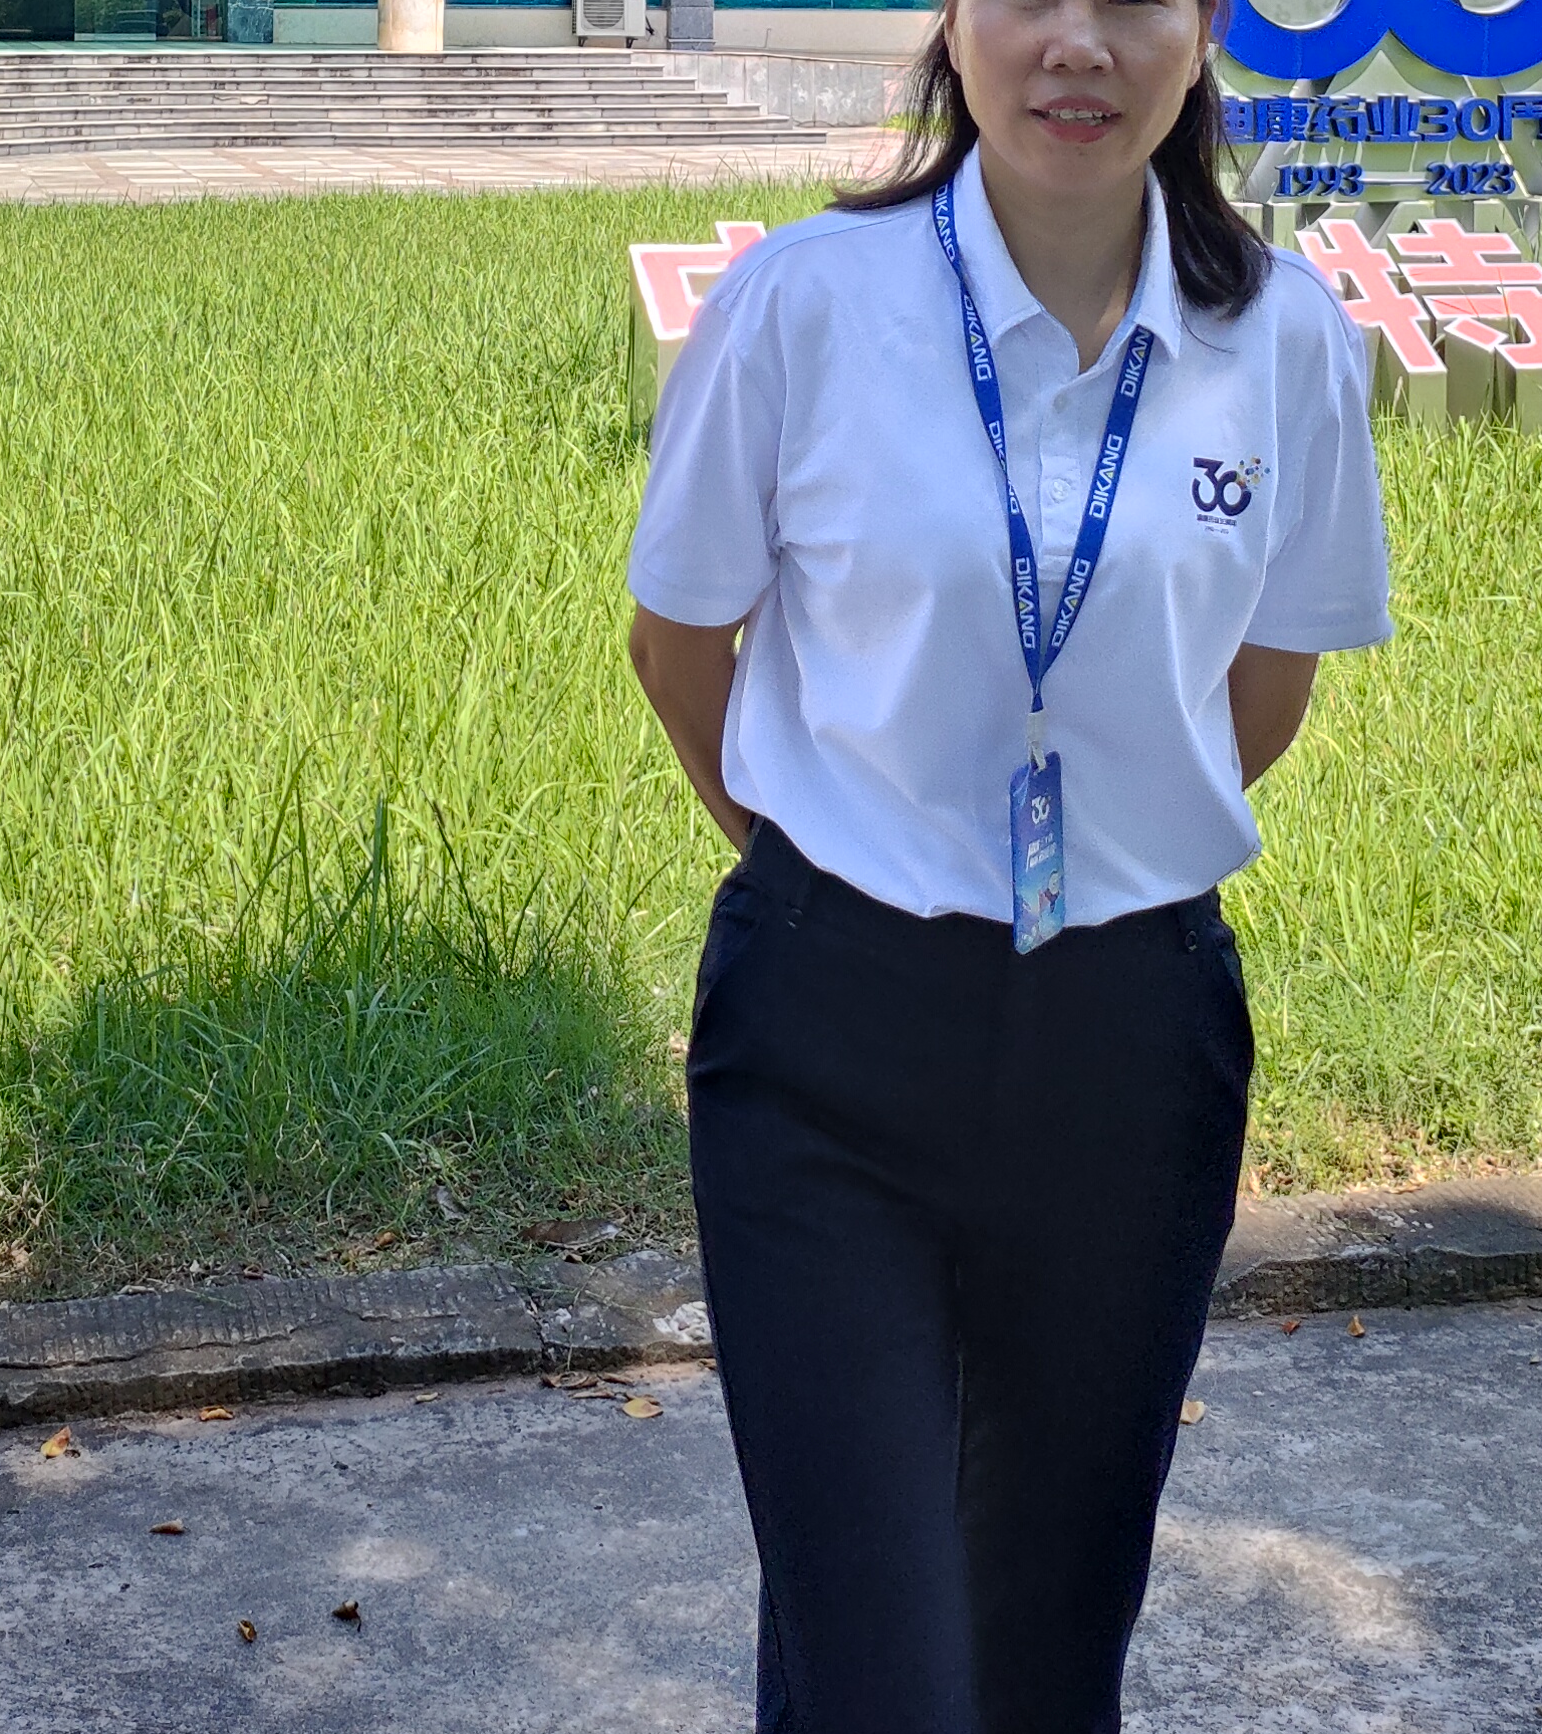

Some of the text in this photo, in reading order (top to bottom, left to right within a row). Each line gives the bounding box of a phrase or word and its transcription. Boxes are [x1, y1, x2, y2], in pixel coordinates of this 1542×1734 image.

[1120, 326, 1152, 398] DIKAN
[1088, 432, 1124, 520] DIKANG
[1015, 556, 1037, 650] DIKANG
